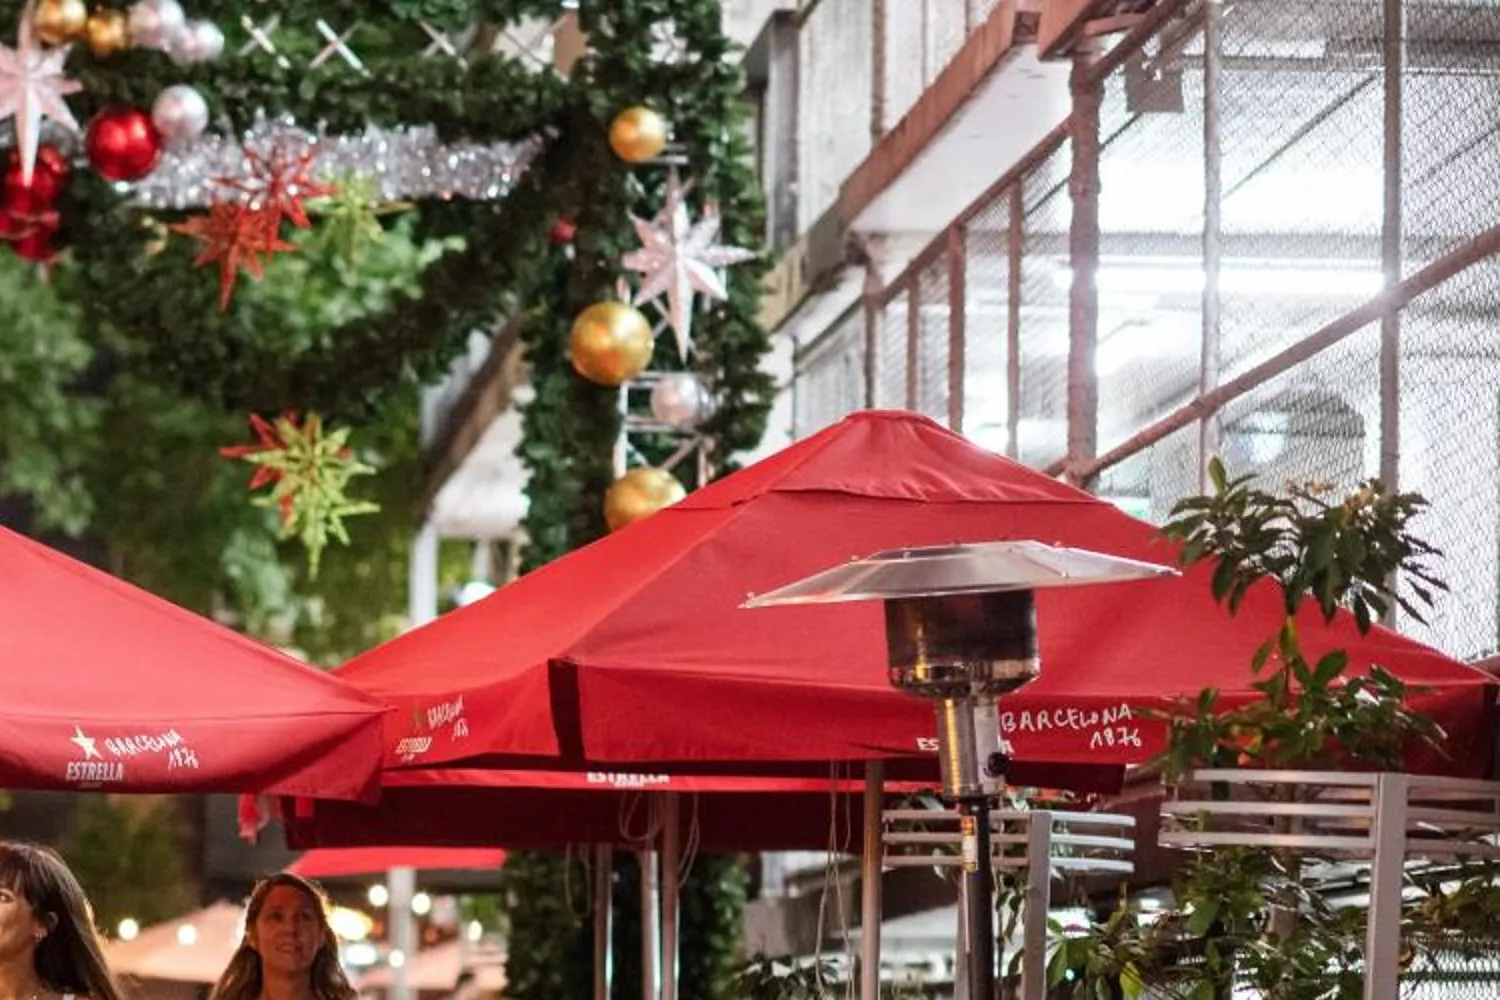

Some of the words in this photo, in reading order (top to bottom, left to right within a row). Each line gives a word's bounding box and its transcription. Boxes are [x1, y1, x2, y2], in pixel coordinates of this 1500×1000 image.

[1001, 704, 1132, 732] BARCELONA
[1090, 727, 1142, 750] 1876
[66, 762, 124, 781] ESTRELLA
